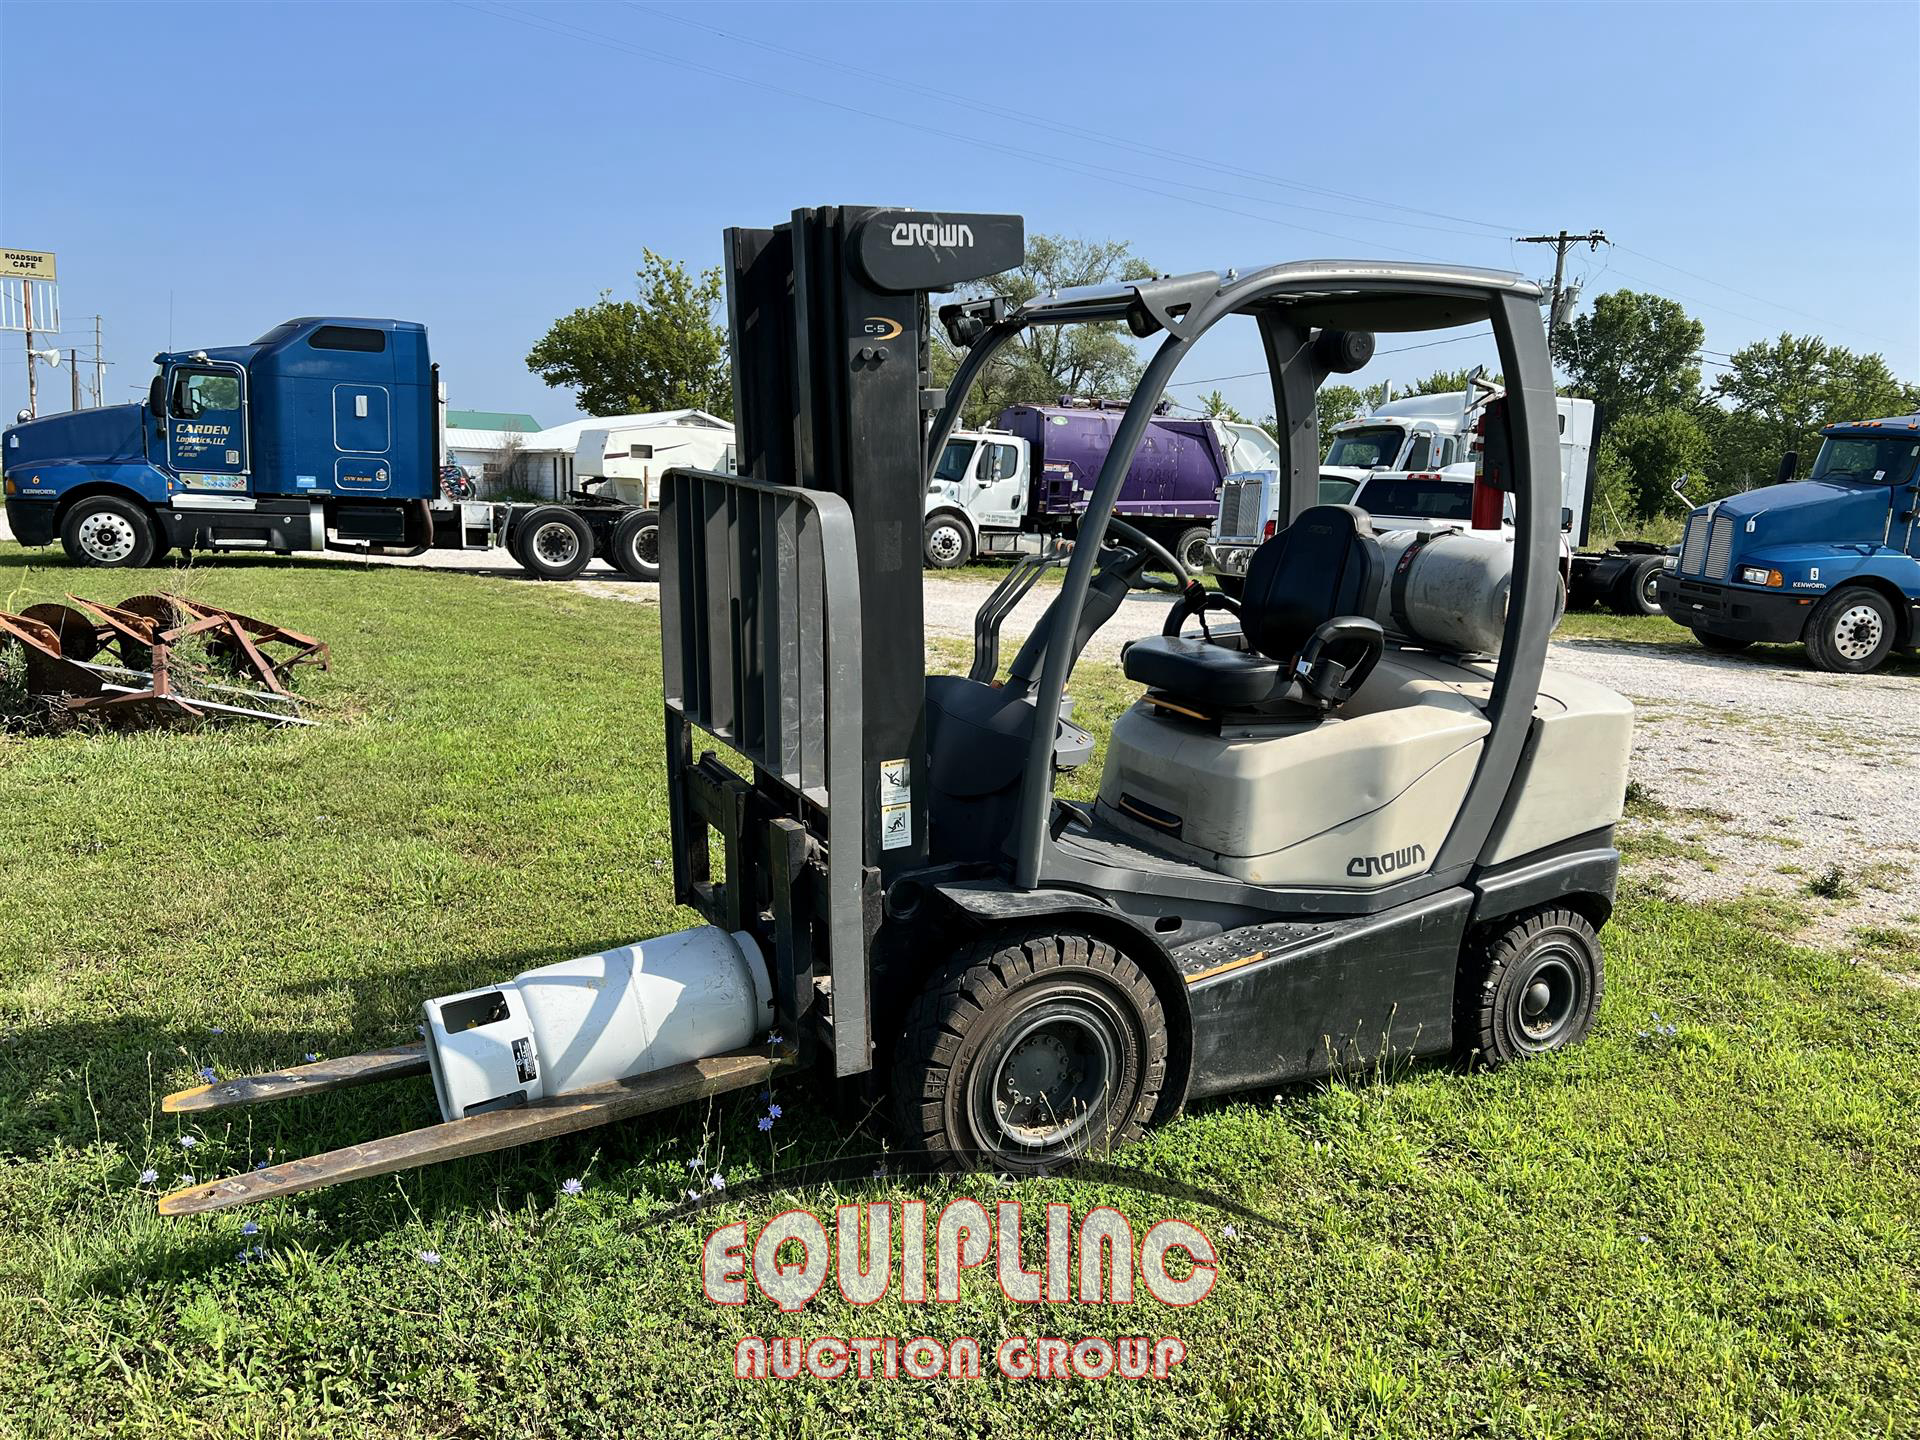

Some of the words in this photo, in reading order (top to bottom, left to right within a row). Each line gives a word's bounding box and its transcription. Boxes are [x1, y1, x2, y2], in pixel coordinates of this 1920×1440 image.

[891, 222, 974, 248] CROWN
[5, 253, 43, 262] ROADSIDE
[176, 424, 230, 434] CARDEN
[176, 436, 212, 444] Logistics,
[32, 475, 40, 484] 6
[1346, 843, 1426, 877] CROWN
